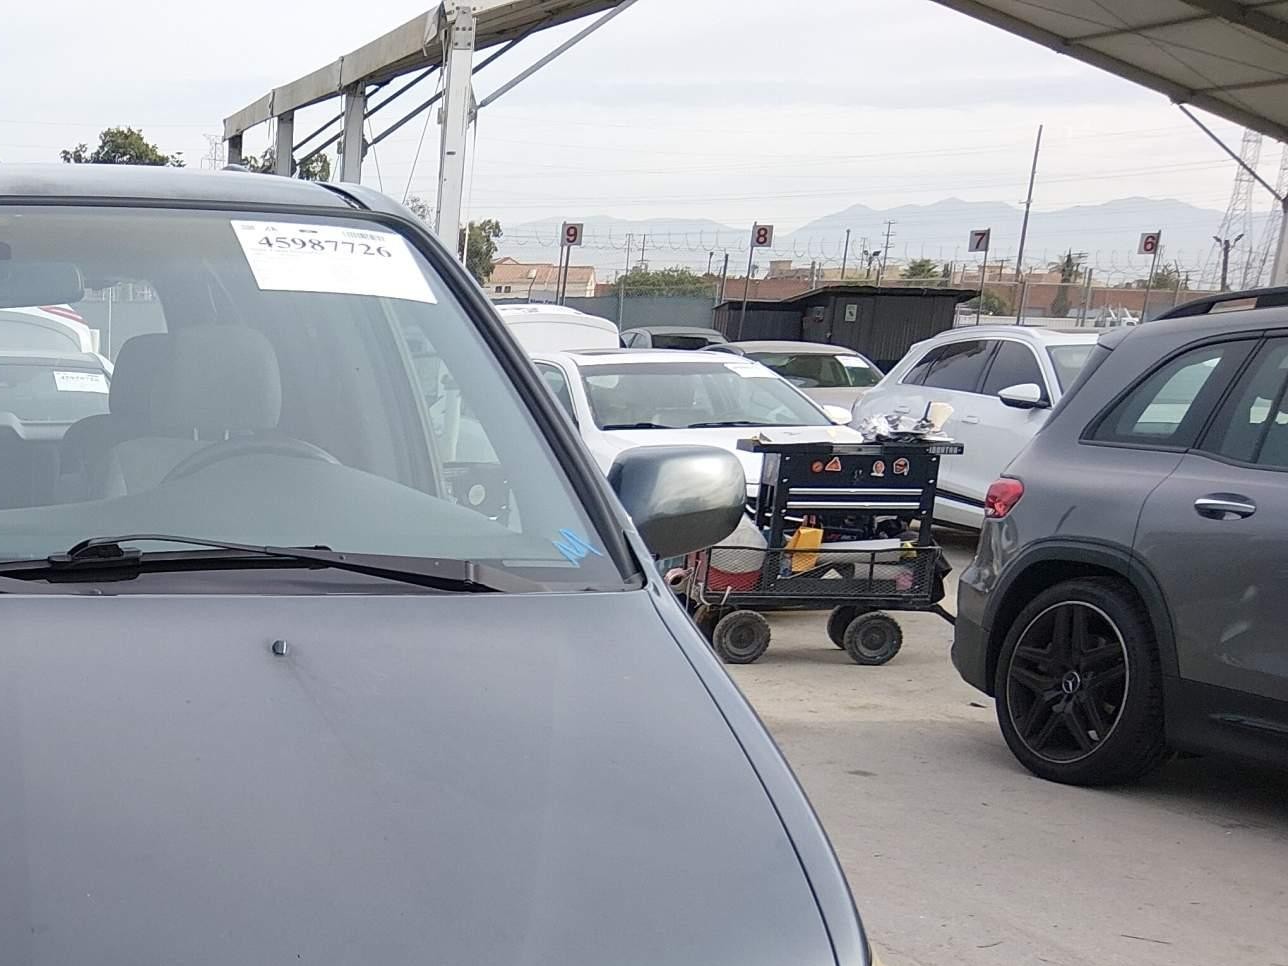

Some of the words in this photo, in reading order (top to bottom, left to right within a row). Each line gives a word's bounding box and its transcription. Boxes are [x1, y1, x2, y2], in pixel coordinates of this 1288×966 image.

[566, 226, 578, 244] 9
[756, 227, 768, 245] 8
[974, 232, 986, 250] 7
[1143, 235, 1156, 252] 6
[258, 235, 392, 258] 45987726
